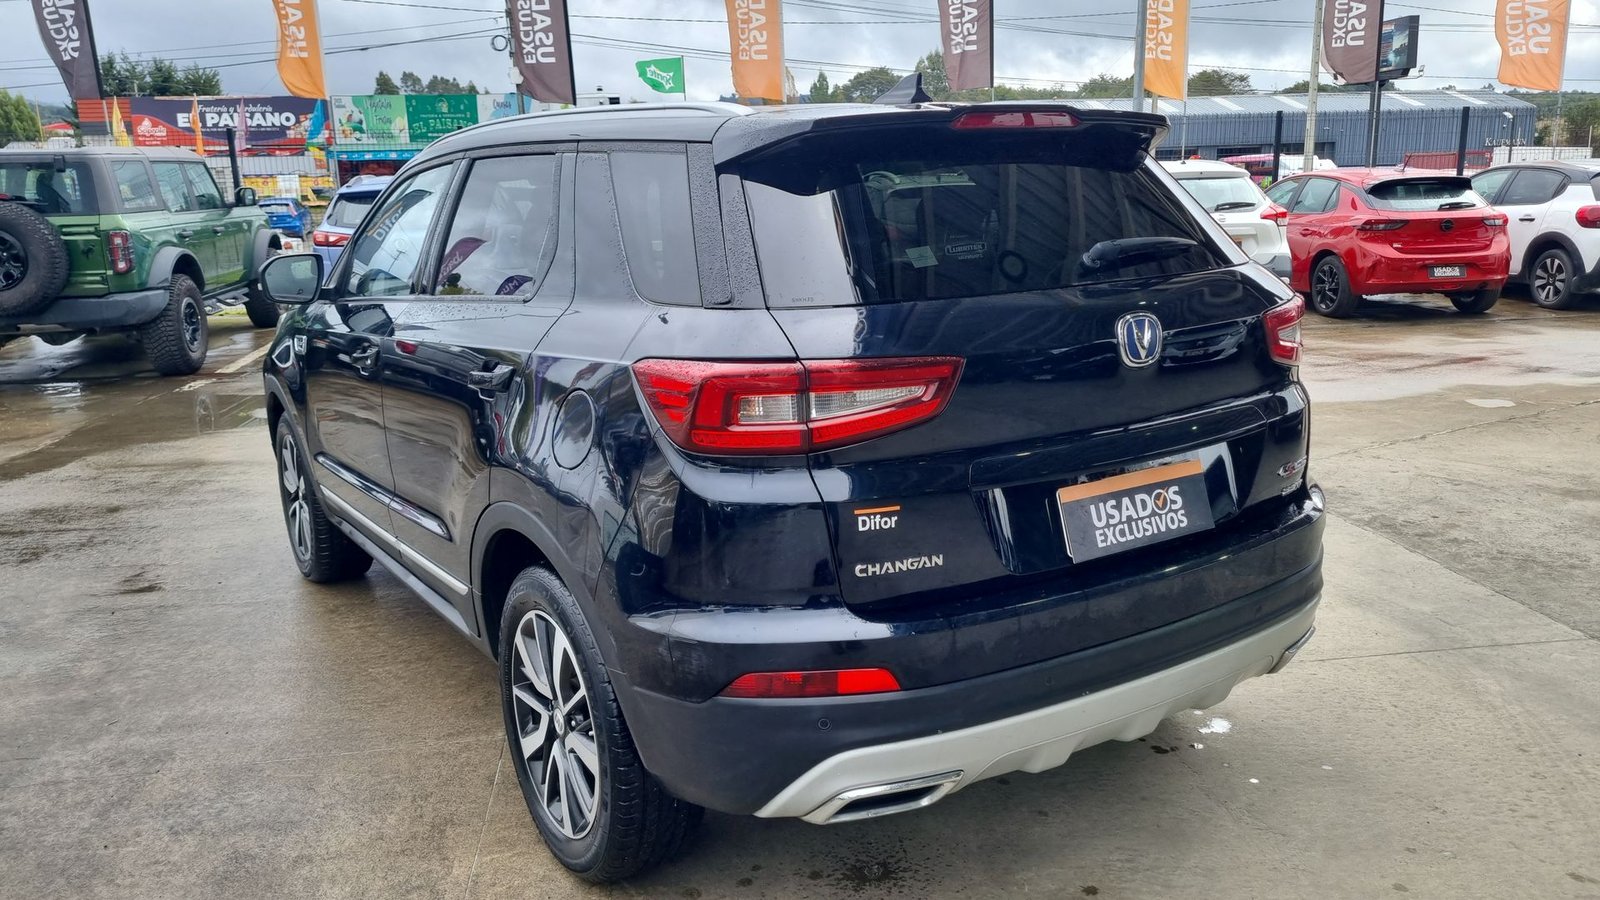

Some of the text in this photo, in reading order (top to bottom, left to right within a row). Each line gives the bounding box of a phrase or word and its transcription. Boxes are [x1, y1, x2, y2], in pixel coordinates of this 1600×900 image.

[1090, 484, 1183, 528] USADOS
[857, 514, 898, 532] Difor
[1095, 509, 1188, 548] EXCLUSIVOS
[854, 554, 944, 578] CHANGAN
